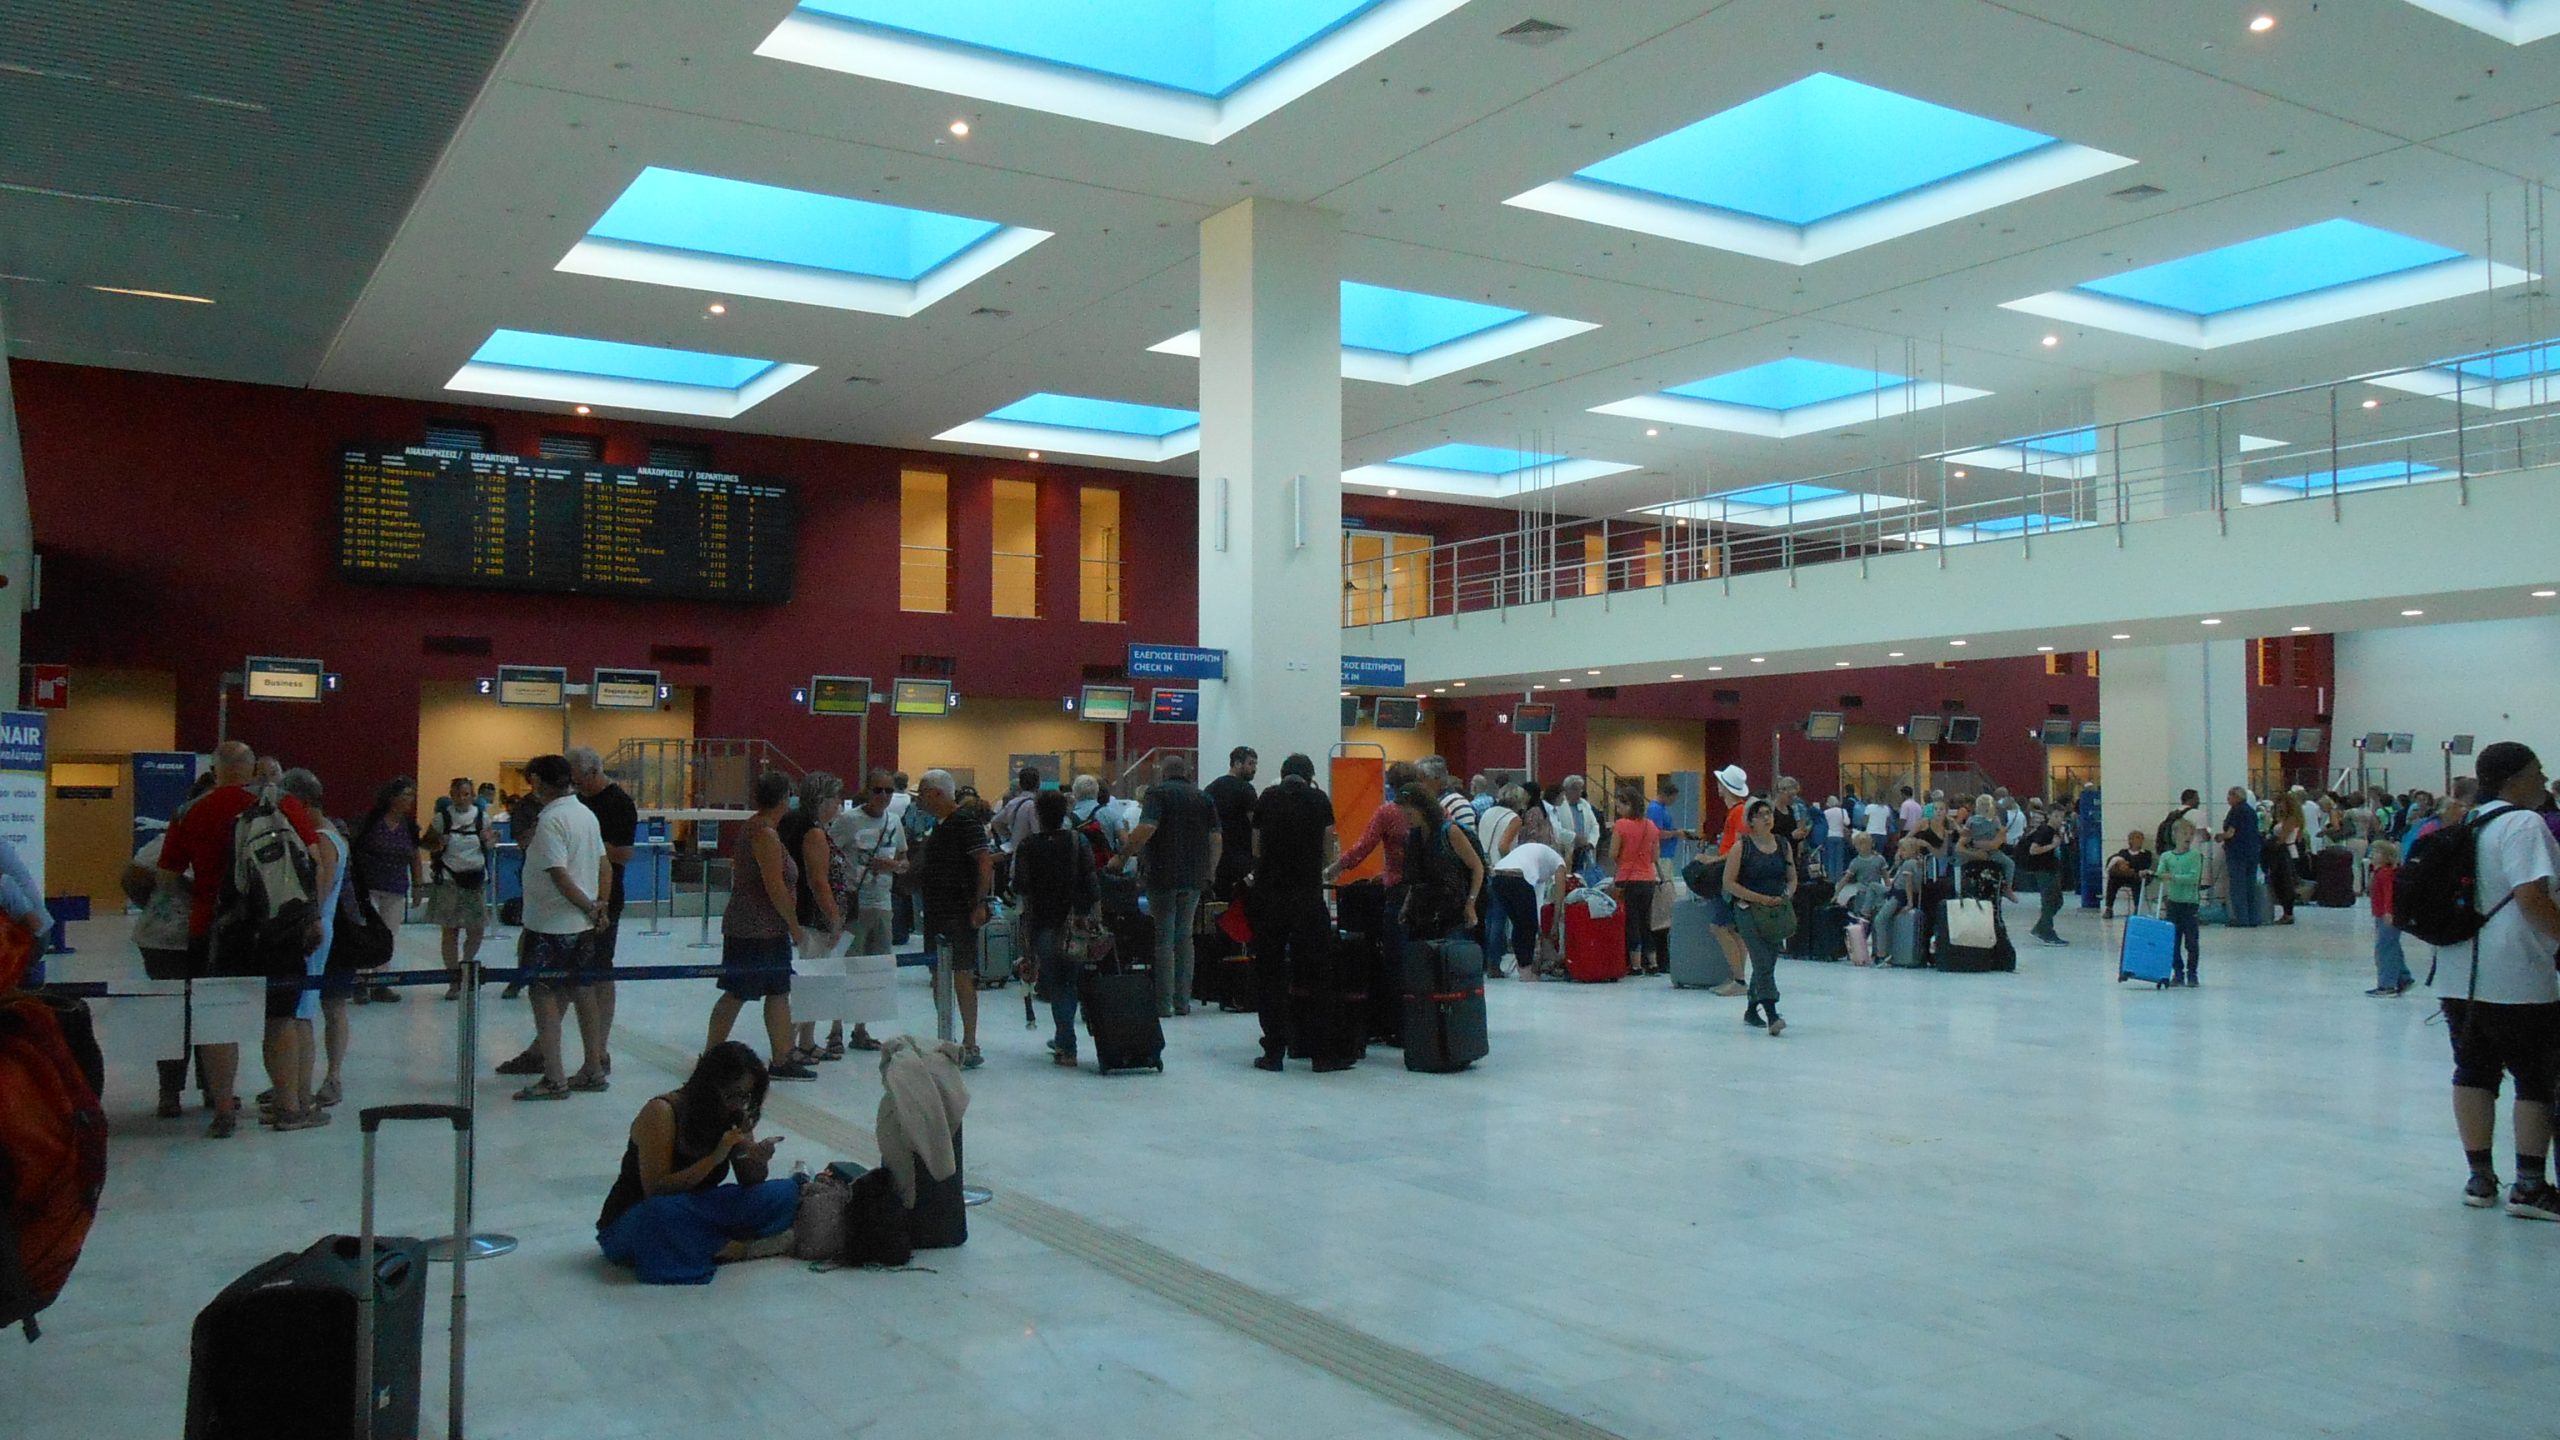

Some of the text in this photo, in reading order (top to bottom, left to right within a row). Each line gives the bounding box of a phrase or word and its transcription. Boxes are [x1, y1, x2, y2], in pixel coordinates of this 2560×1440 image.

[470, 452, 519, 464] DEPARTURES
[696, 472, 739, 483] DEPARTURES
[1134, 650, 1220, 663] ΕΛΕΓΧΟΣ ΕΙΣΙΤΗΡΙΩΝ
[1134, 663, 1161, 672] CHECK
[1361, 662, 1402, 672] ΕΙΣΙΤΗΡΙΩΝ
[265, 679, 303, 688] Business
[327, 677, 336, 688] 1
[481, 681, 490, 693] 2
[659, 687, 668, 698] 3
[795, 691, 803, 701] 4
[949, 695, 957, 706] 5
[1066, 700, 1073, 710] 6
[1498, 714, 1507, 724] 10
